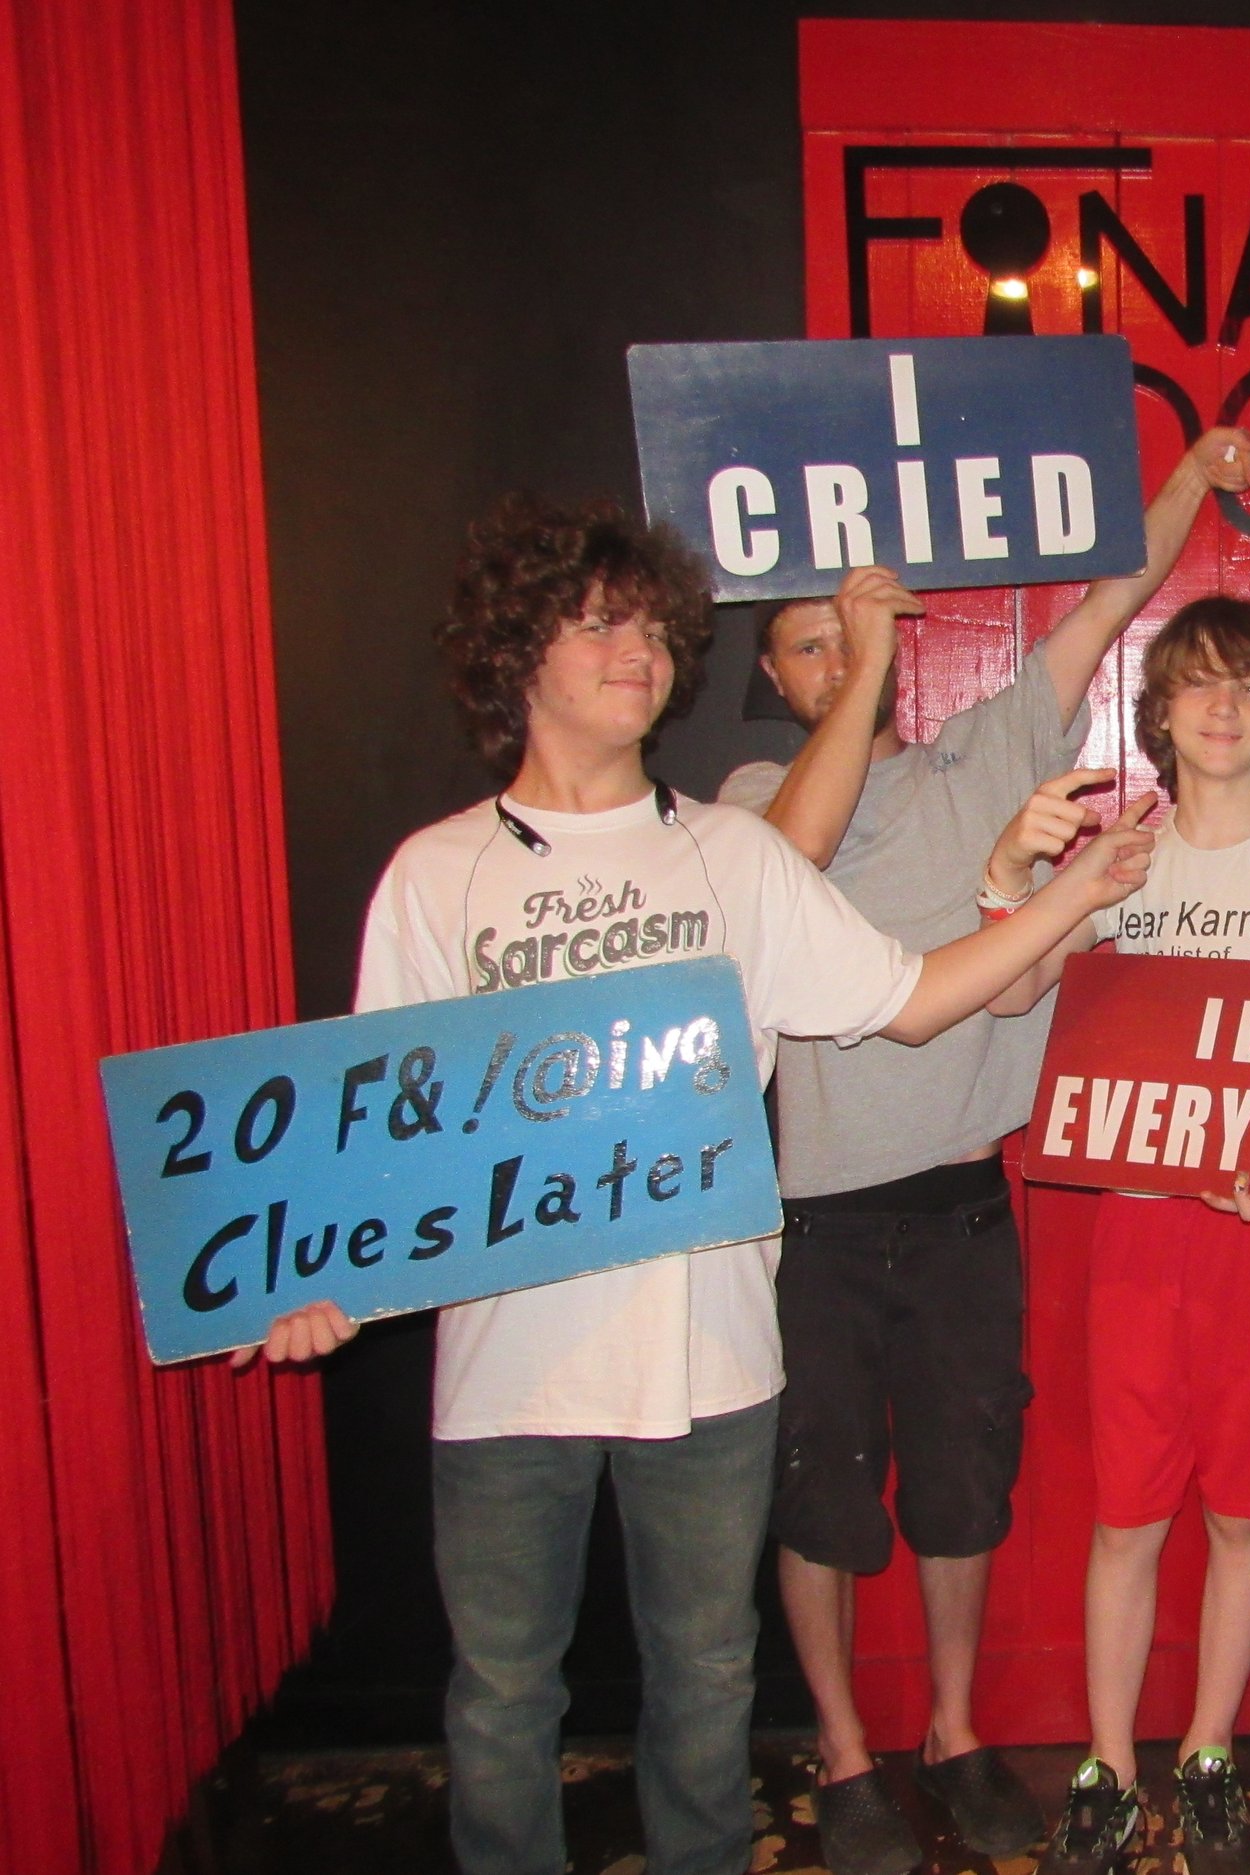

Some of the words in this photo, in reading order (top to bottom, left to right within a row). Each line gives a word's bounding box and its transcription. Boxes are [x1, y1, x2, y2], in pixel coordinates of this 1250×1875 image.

[889, 354, 920, 446] I
[708, 455, 1098, 577] CRIED
[523, 880, 647, 929] Fresh
[1116, 907, 1169, 941] ear
[474, 909, 709, 995] Sarcasm
[1195, 998, 1224, 1060] I
[156, 1075, 296, 1179] 20
[183, 1200, 458, 1312] Clues
[486, 1137, 733, 1248] Later
